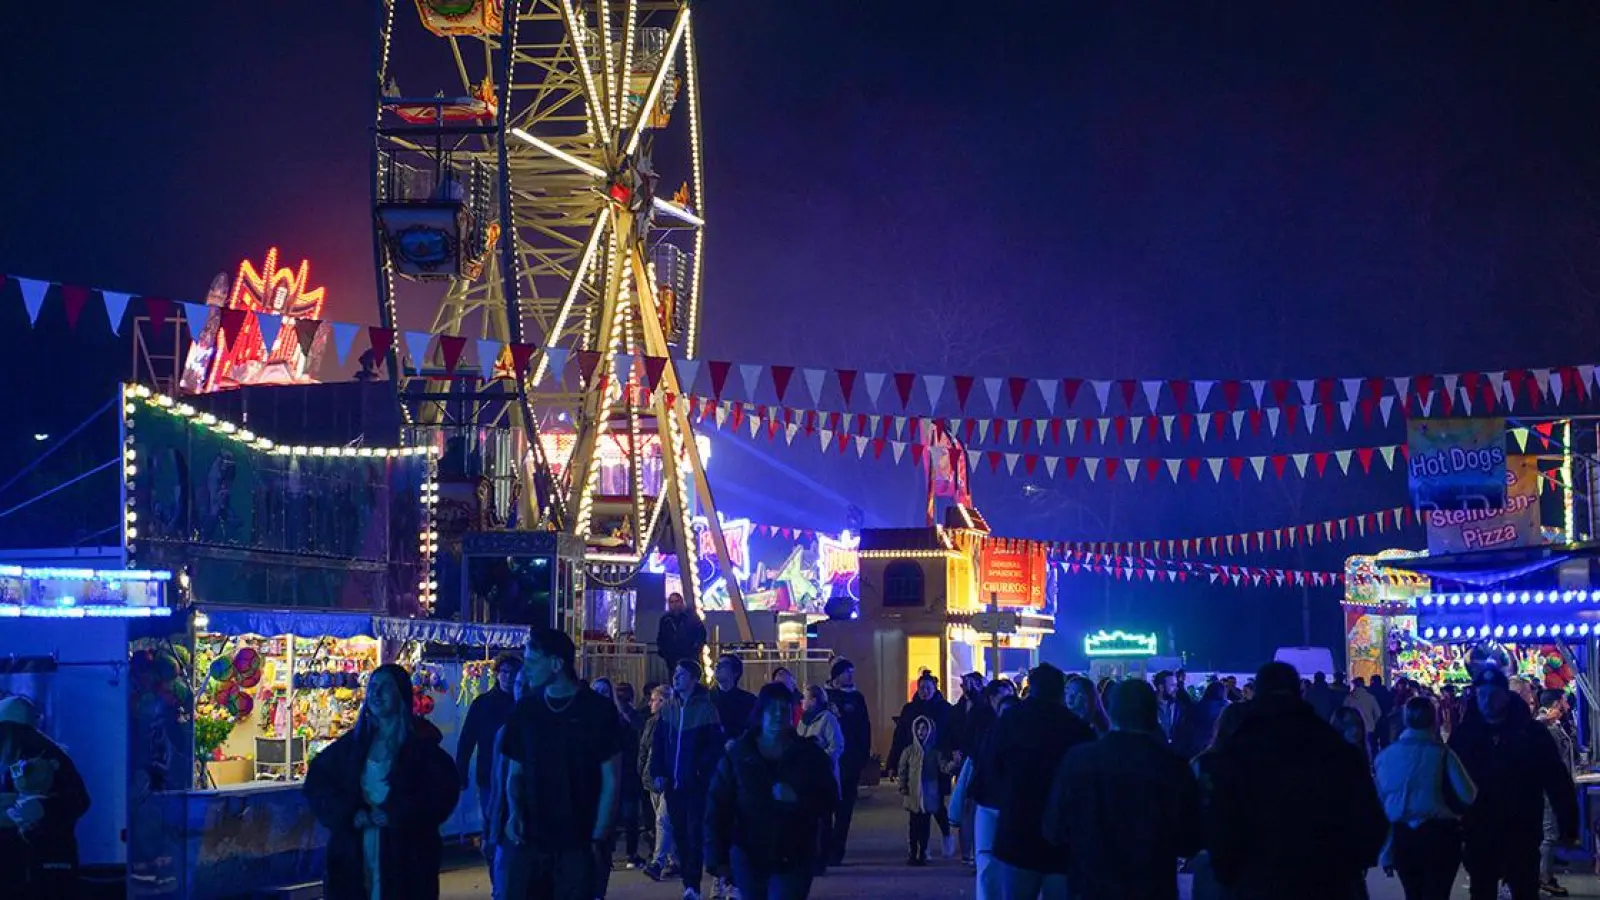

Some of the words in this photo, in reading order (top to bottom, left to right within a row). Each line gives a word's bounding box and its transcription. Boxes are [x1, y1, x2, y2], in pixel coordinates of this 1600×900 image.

[1412, 452, 1448, 476] Hot
[1450, 447, 1503, 471] Dogs
[1463, 525, 1516, 548] Pizza
[983, 582, 1027, 593] CHURROS
